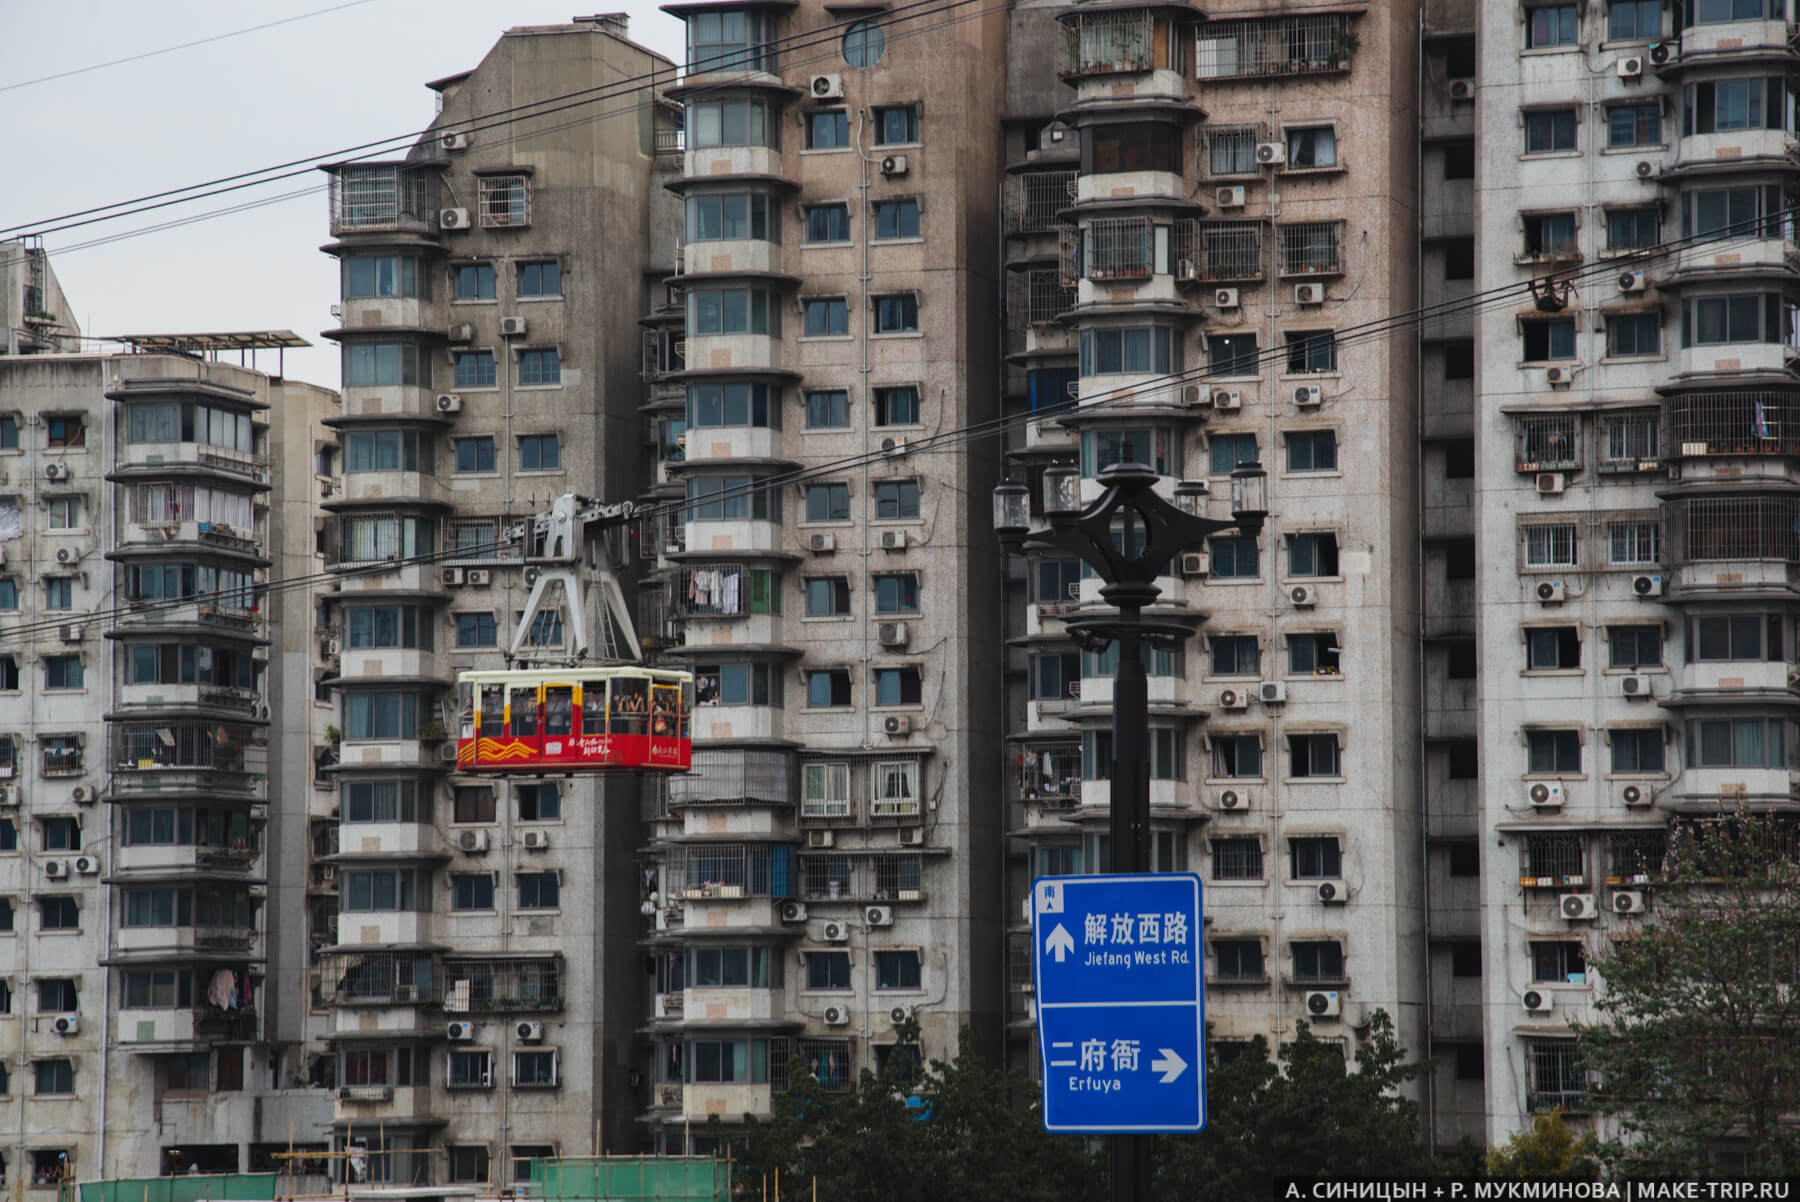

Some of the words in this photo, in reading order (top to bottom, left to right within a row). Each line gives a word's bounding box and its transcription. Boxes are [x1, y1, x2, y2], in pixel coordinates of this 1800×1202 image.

[1084, 911, 1188, 945] 解放西路
[1085, 951, 1131, 969] Jiefang
[1134, 950, 1166, 965] West
[1171, 949, 1190, 965] Rd.
[1050, 1038, 1141, 1072] 二府衙
[1069, 1076, 1121, 1095] Erfuya
